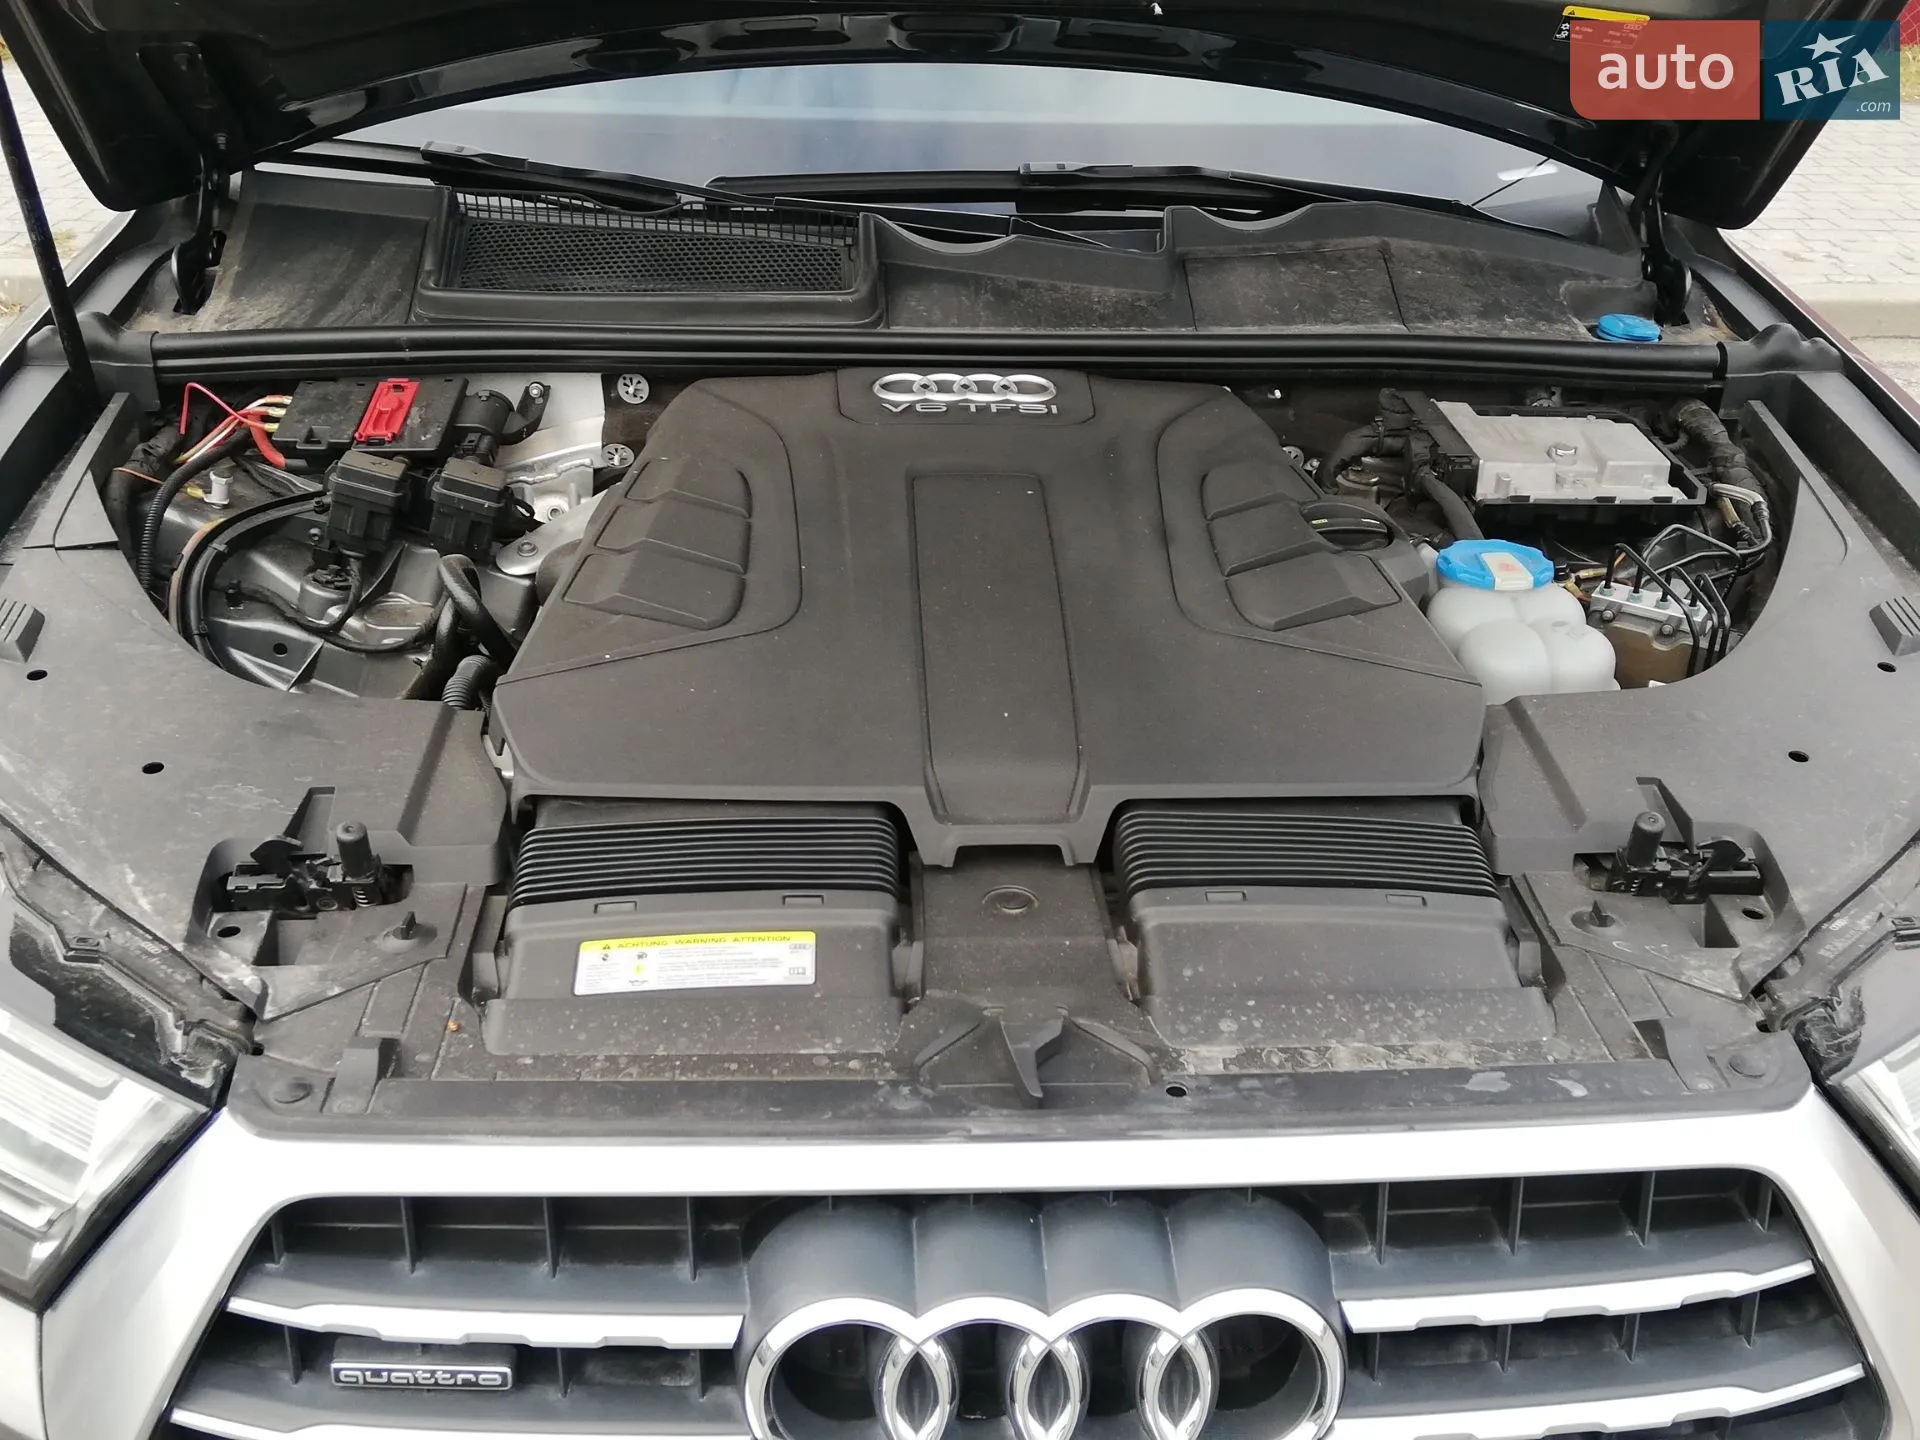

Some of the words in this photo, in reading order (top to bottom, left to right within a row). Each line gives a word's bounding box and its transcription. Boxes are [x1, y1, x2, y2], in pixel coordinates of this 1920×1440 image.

[881, 402, 948, 413] V6
[958, 402, 1058, 414] TFSI
[617, 940, 668, 949] ACHTUNG
[675, 936, 727, 945] WARNING
[732, 935, 791, 943] ATTENTION
[339, 1370, 502, 1386] quattro
